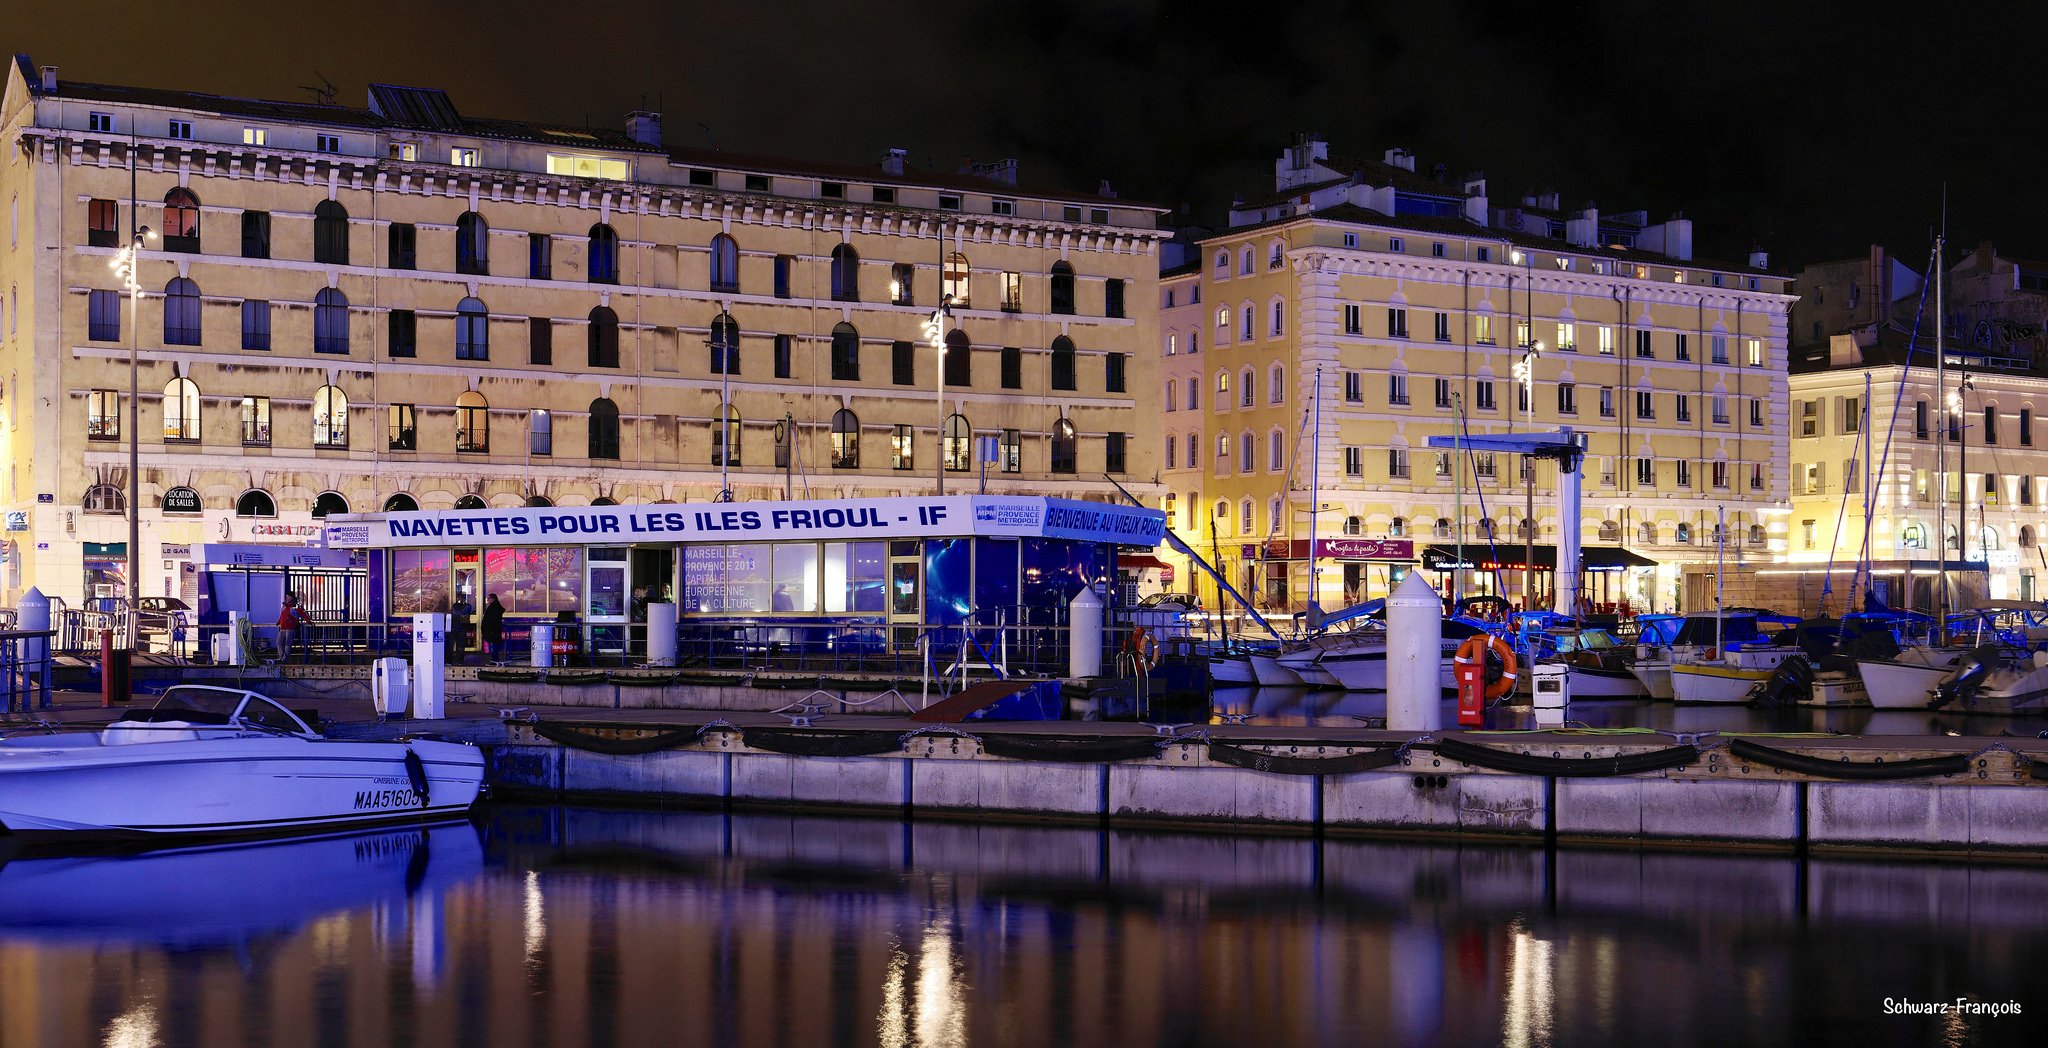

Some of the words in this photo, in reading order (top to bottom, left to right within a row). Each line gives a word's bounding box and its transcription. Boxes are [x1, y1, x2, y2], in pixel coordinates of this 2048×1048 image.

[168, 490, 194, 498] LOCATION
[177, 499, 195, 507] SALLES
[389, 516, 530, 537] NAVETTES
[539, 514, 620, 534] POUR
[630, 512, 685, 532] LES
[695, 510, 762, 531] ILES
[772, 507, 888, 529] FRIOUL
[918, 505, 947, 525] IF
[1047, 507, 1101, 531] BIENVENUE
[1100, 513, 1112, 532] AU
[1114, 514, 1141, 534] VIEUX
[1140, 517, 1165, 537] PORT
[252, 525, 292, 535] CASA
[685, 561, 732, 572] PROVENCE
[734, 560, 756, 571] 2013
[685, 574, 725, 584] CAPITALE
[685, 599, 697, 609] DE
[700, 599, 711, 608] LA
[713, 598, 755, 609] CULTURE
[373, 776, 400, 785] OMBRINE
